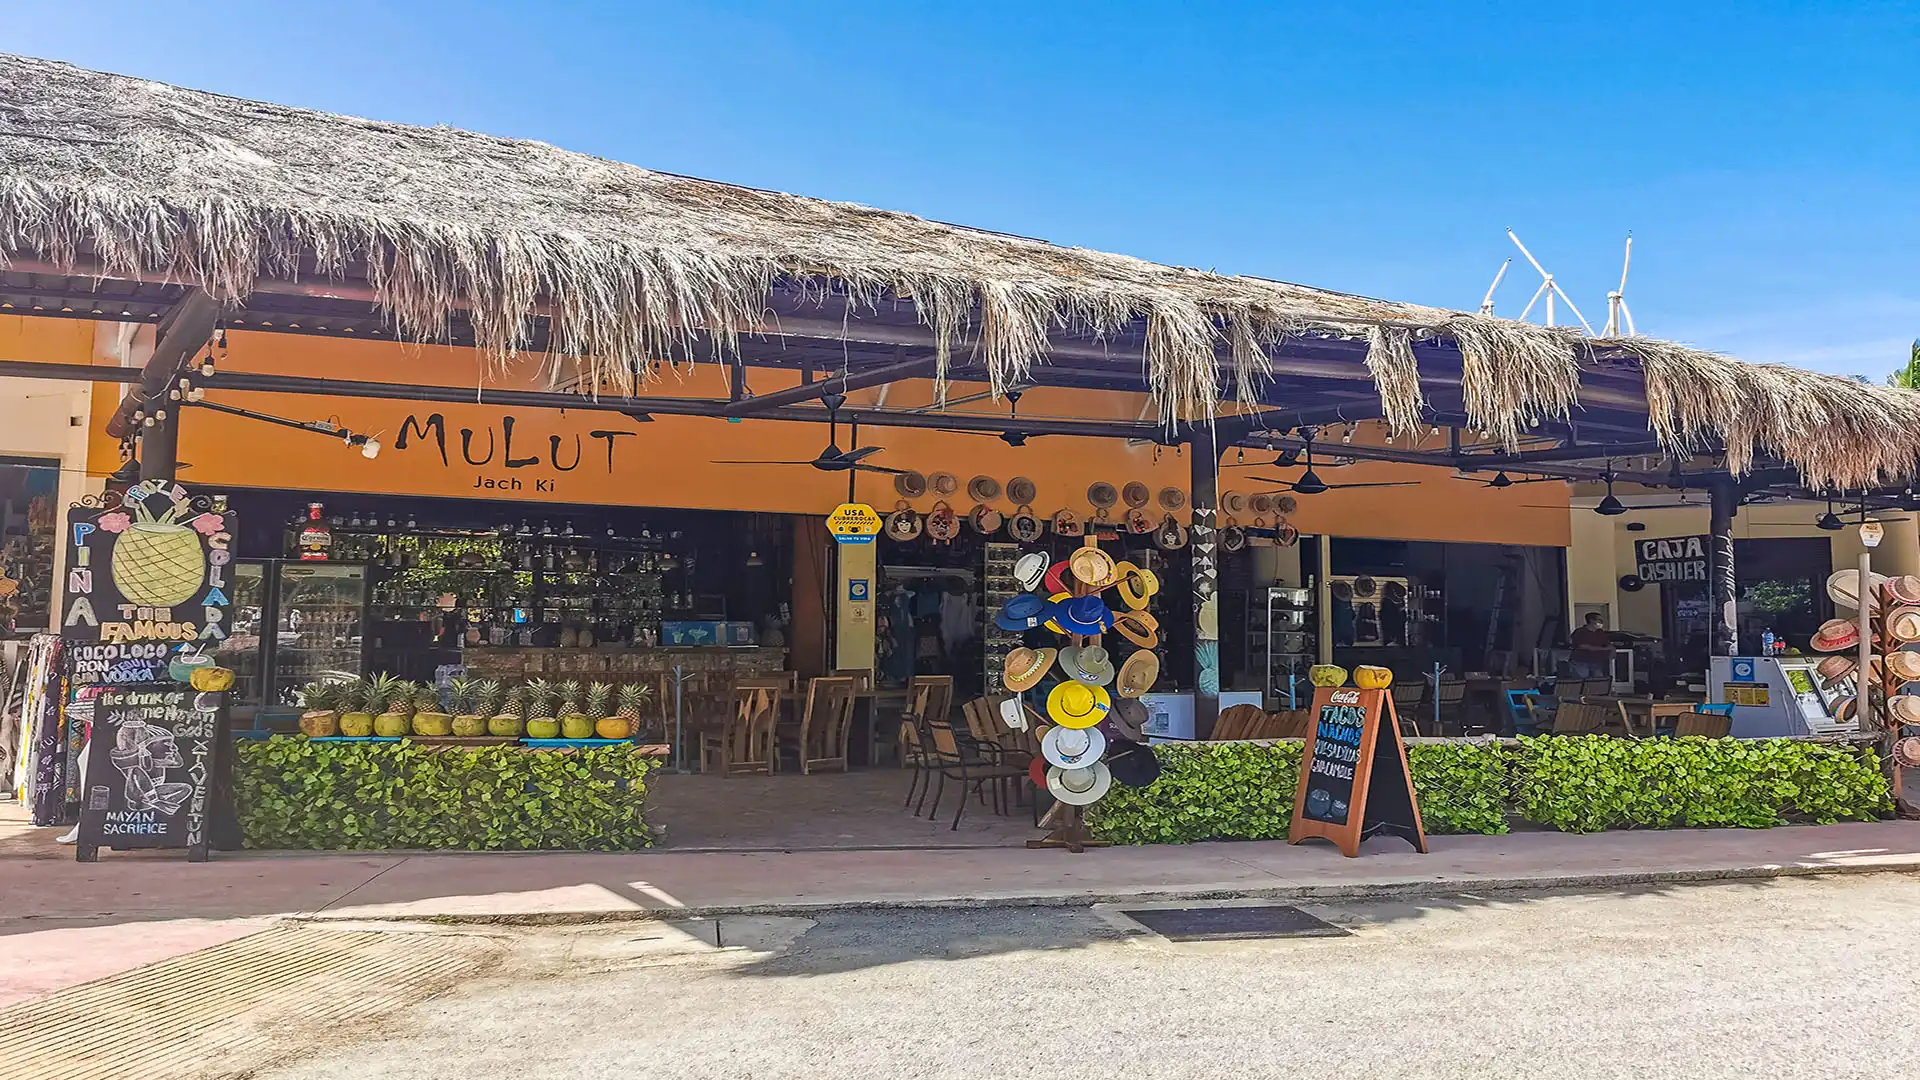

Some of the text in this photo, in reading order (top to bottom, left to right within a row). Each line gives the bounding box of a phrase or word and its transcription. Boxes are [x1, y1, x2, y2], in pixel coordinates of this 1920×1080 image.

[395, 413, 637, 474] MULUT
[473, 476, 556, 492] Jach Ki
[1642, 537, 1705, 560] CAJA
[1639, 561, 1706, 581] CASHIER
[199, 531, 233, 640] COLADA
[100, 620, 198, 644] FAMOUS
[73, 643, 168, 660] COCO LOCO
[76, 660, 110, 673] RON
[101, 668, 154, 683] VODKA
[1321, 705, 1367, 728] TACOS
[1317, 720, 1364, 746] NACHOS
[106, 811, 155, 823] MAYAN
[103, 823, 168, 835] SACRIFICE
